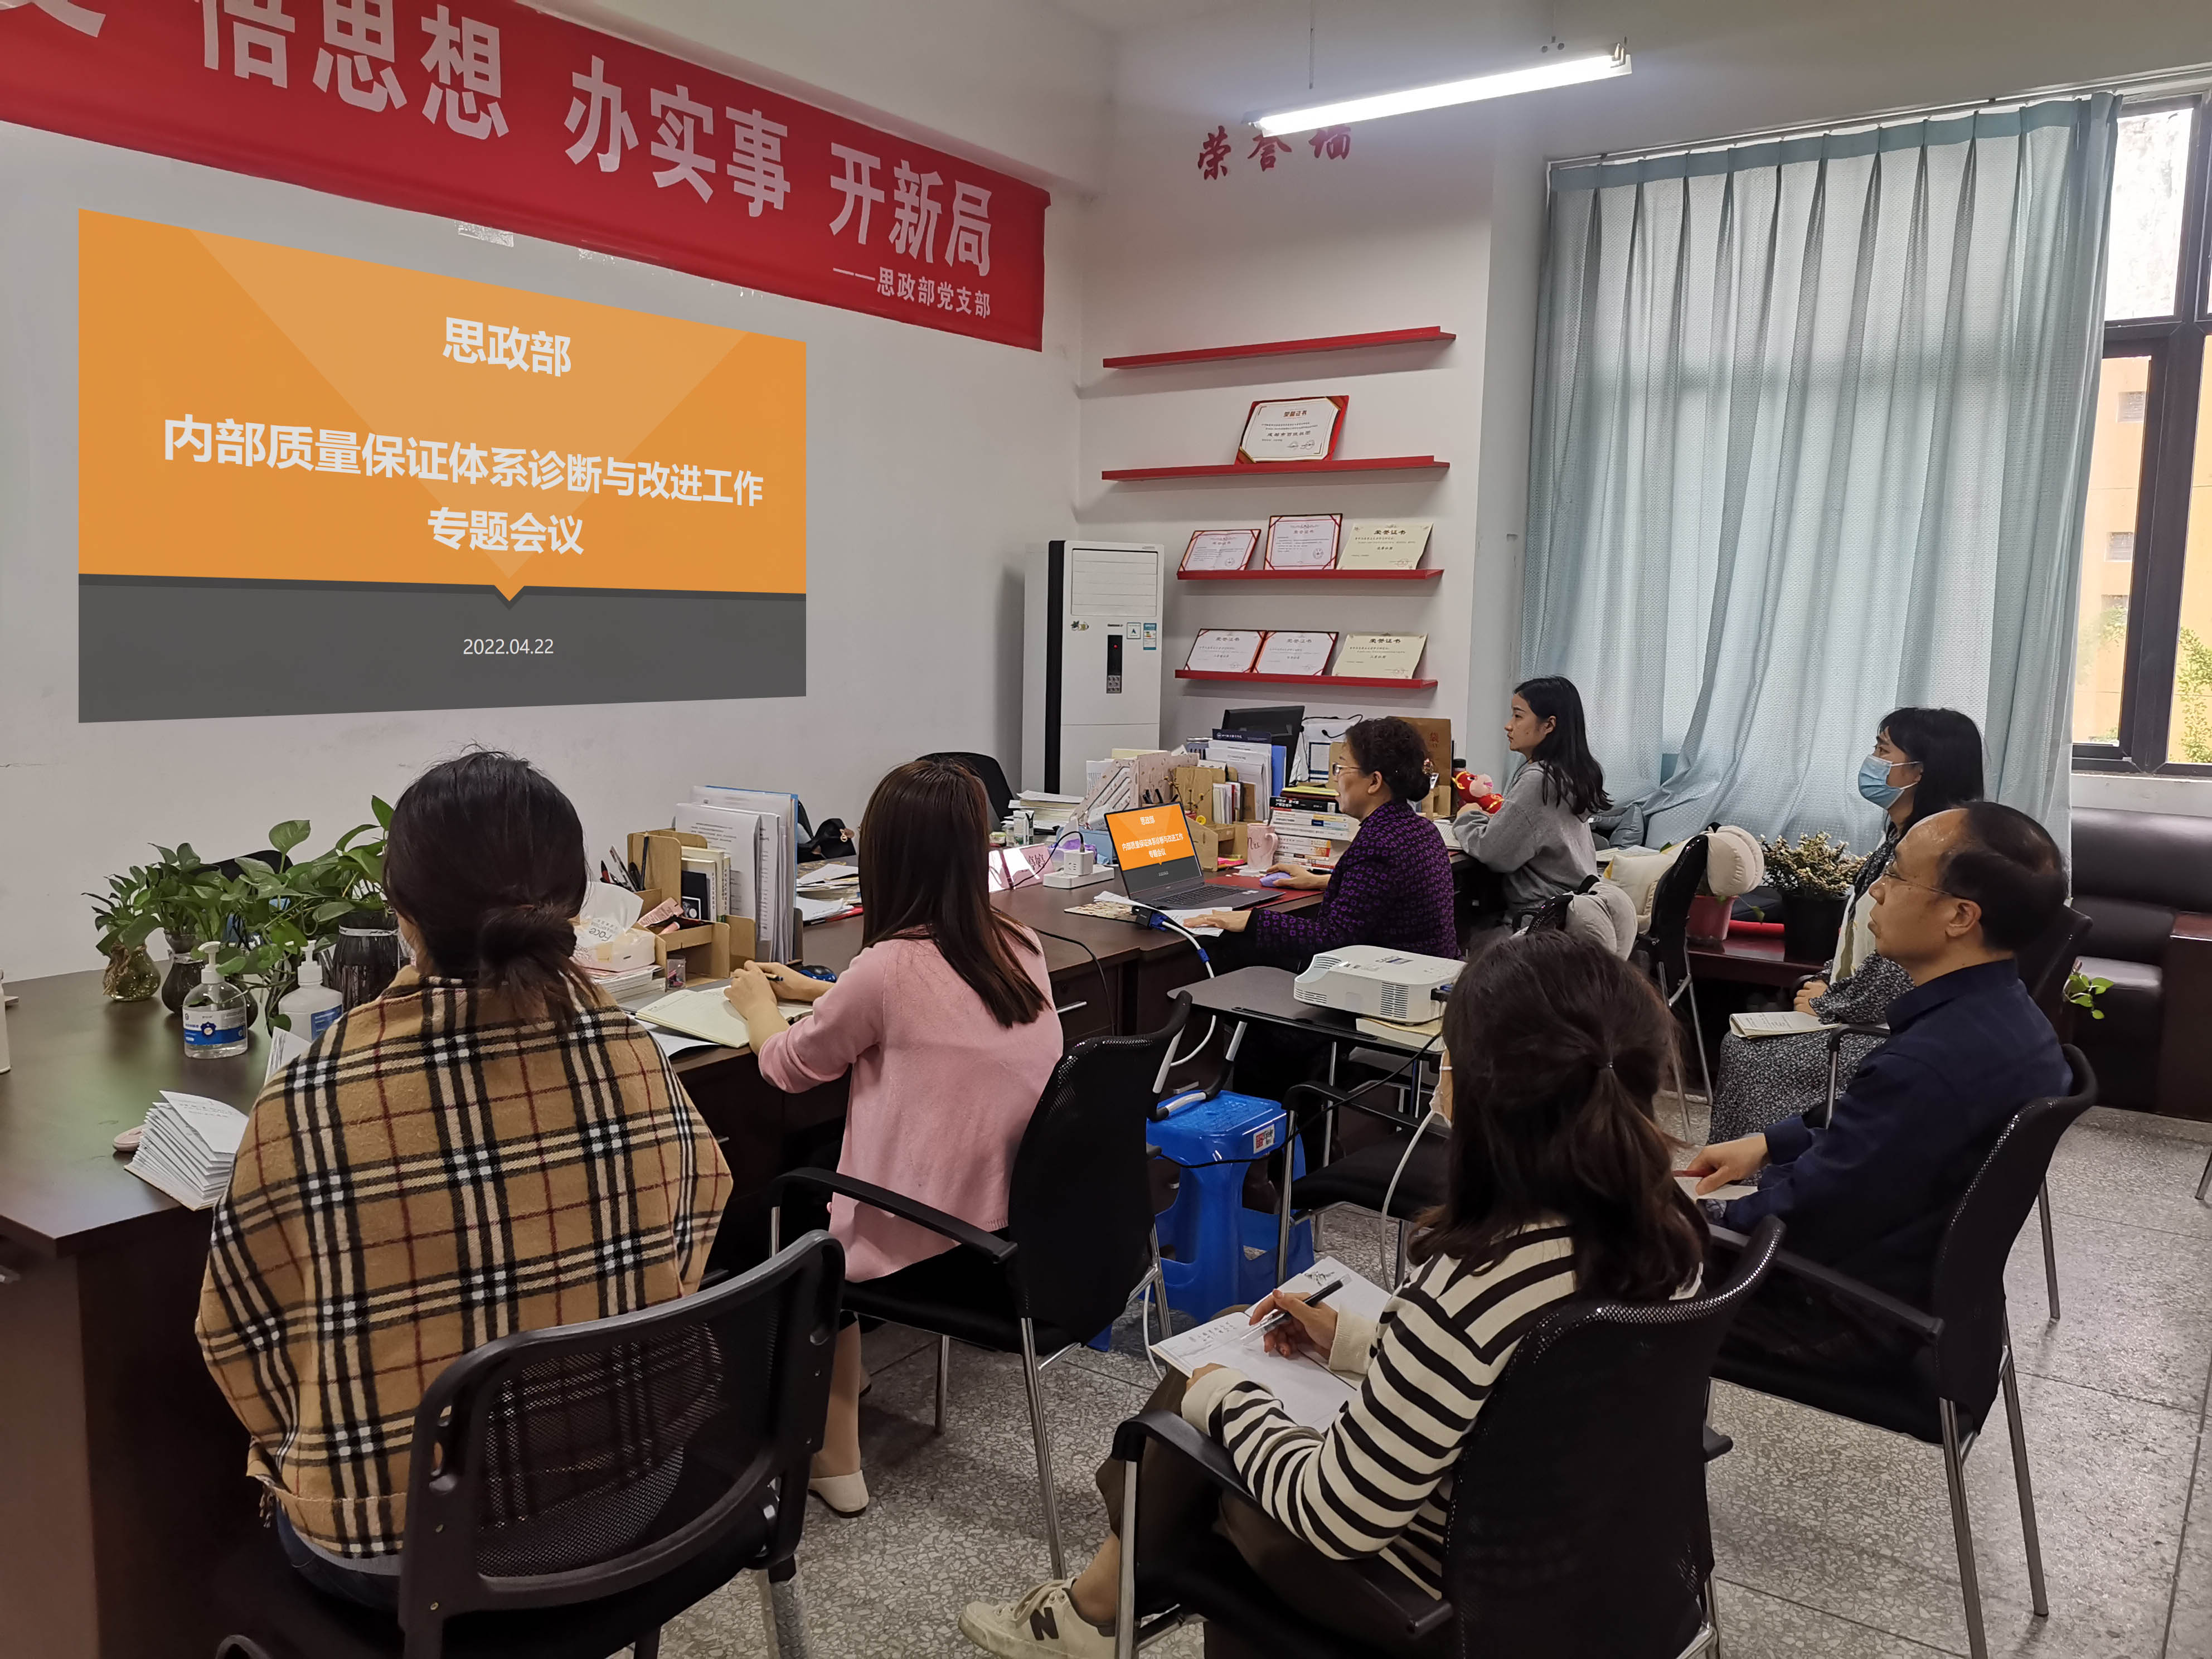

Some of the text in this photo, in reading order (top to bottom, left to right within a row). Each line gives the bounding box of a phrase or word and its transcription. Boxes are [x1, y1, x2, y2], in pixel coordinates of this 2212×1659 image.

[564, 54, 790, 217] 办实事
[829, 142, 993, 277] 开新局
[443, 316, 572, 377] 思政部
[163, 414, 764, 507] 内部质量保证体系诊断与改进工作
[428, 506, 585, 555] 专题会议
[463, 637, 554, 656] 2022.04.22
[589, 928, 612, 942] Face
